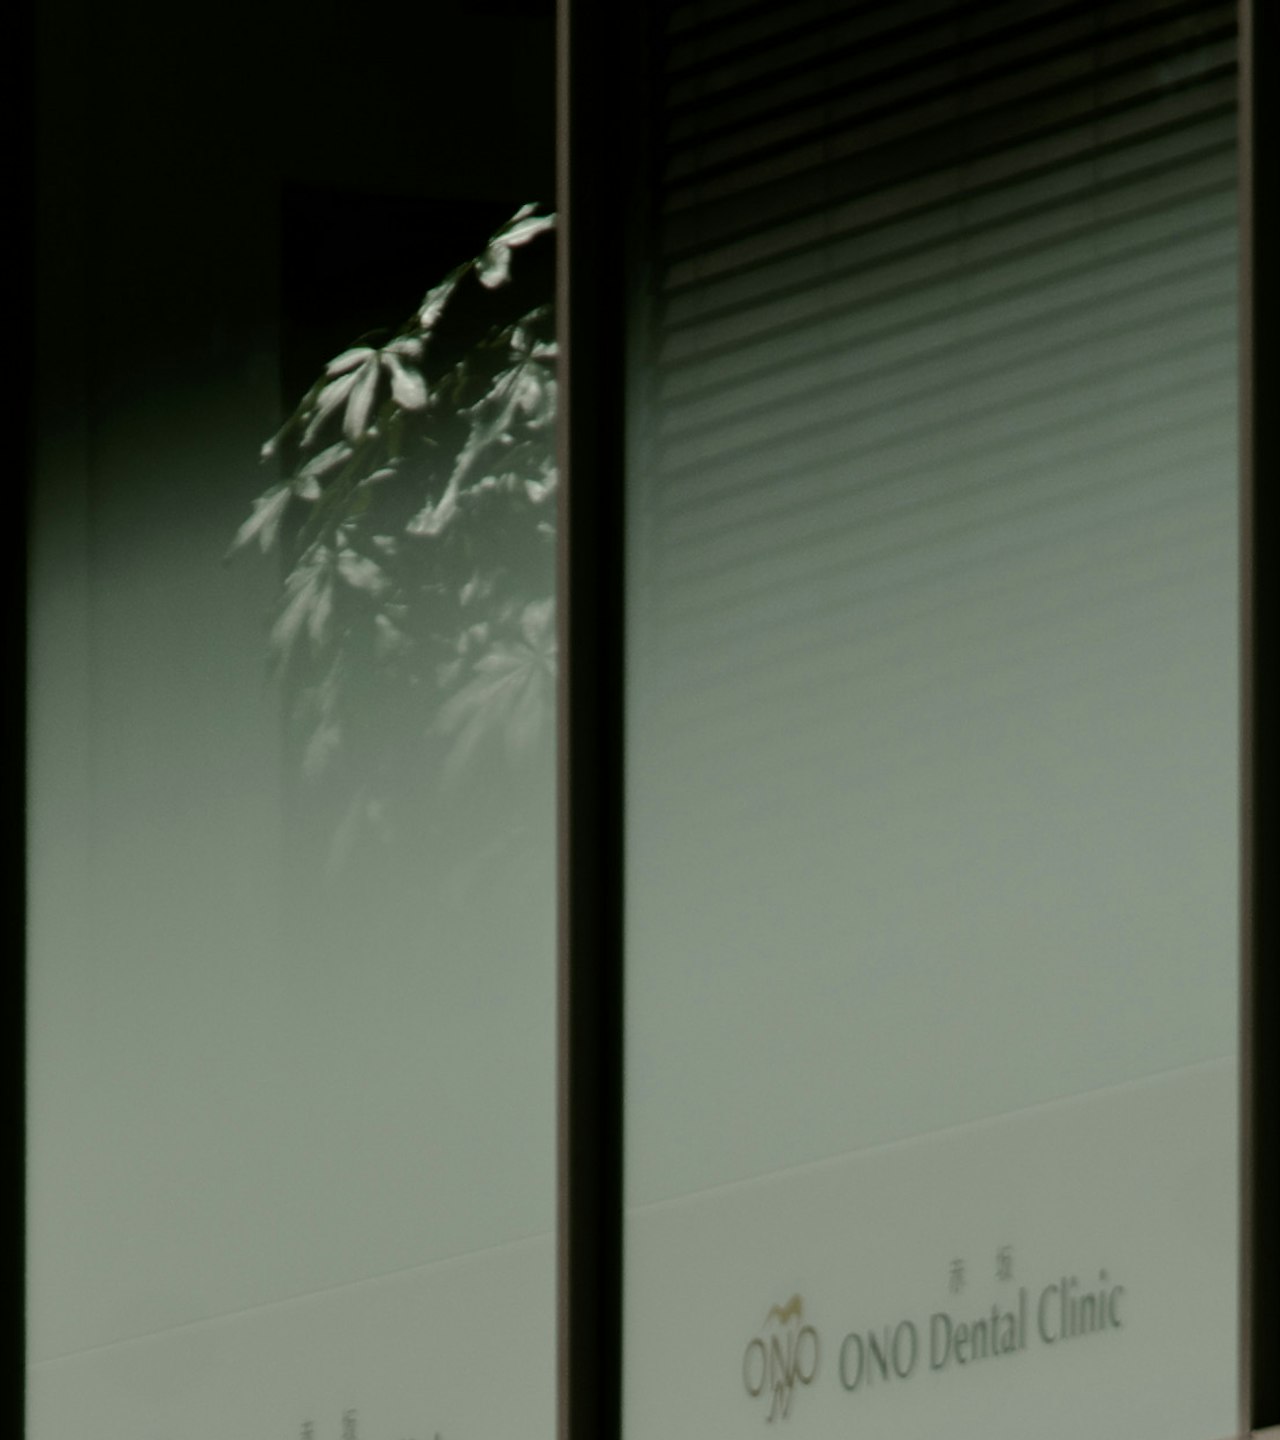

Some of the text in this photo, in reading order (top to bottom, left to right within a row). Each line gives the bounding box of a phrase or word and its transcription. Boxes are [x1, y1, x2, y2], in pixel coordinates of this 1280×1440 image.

[839, 1320, 918, 1392] ONO
[930, 1287, 1026, 1371] Dental
[1037, 1269, 1125, 1344] Clinic
